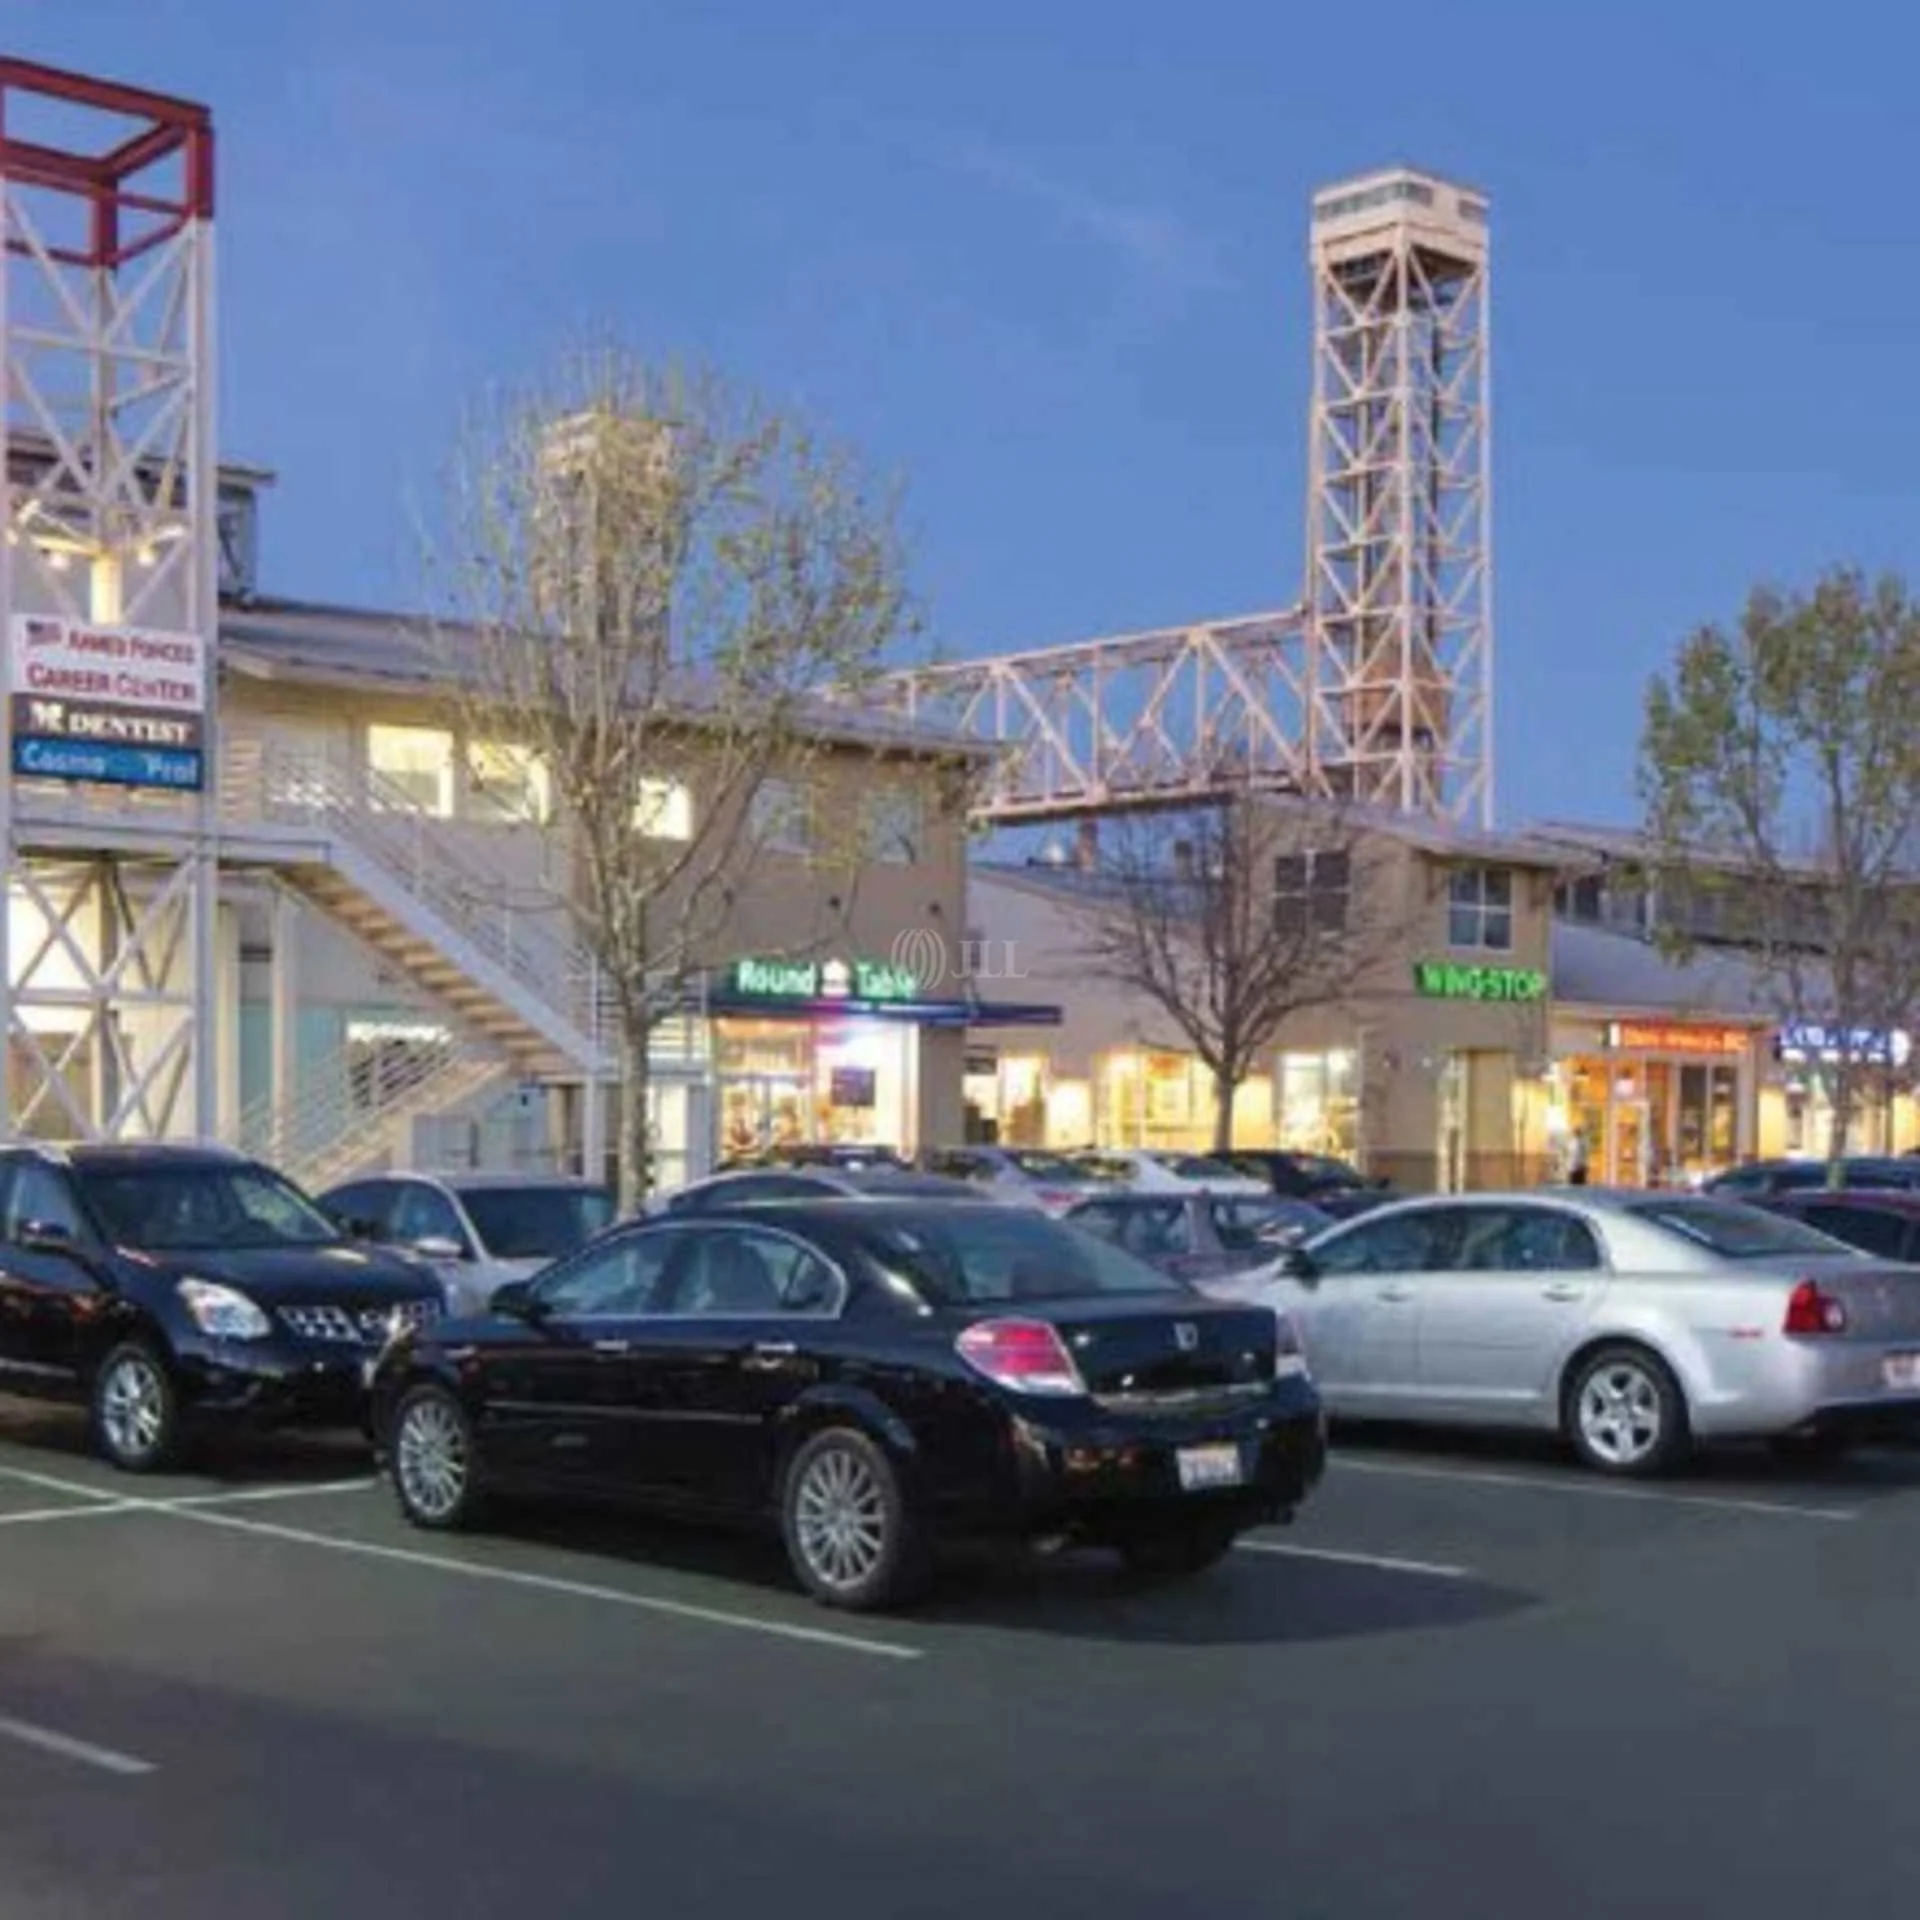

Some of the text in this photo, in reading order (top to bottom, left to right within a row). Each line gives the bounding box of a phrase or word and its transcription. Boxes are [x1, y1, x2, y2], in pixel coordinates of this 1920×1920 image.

[26, 661, 196, 699] CAREER CENTER
[68, 712, 192, 745] DENTIST
[738, 959, 918, 998] Round Table
